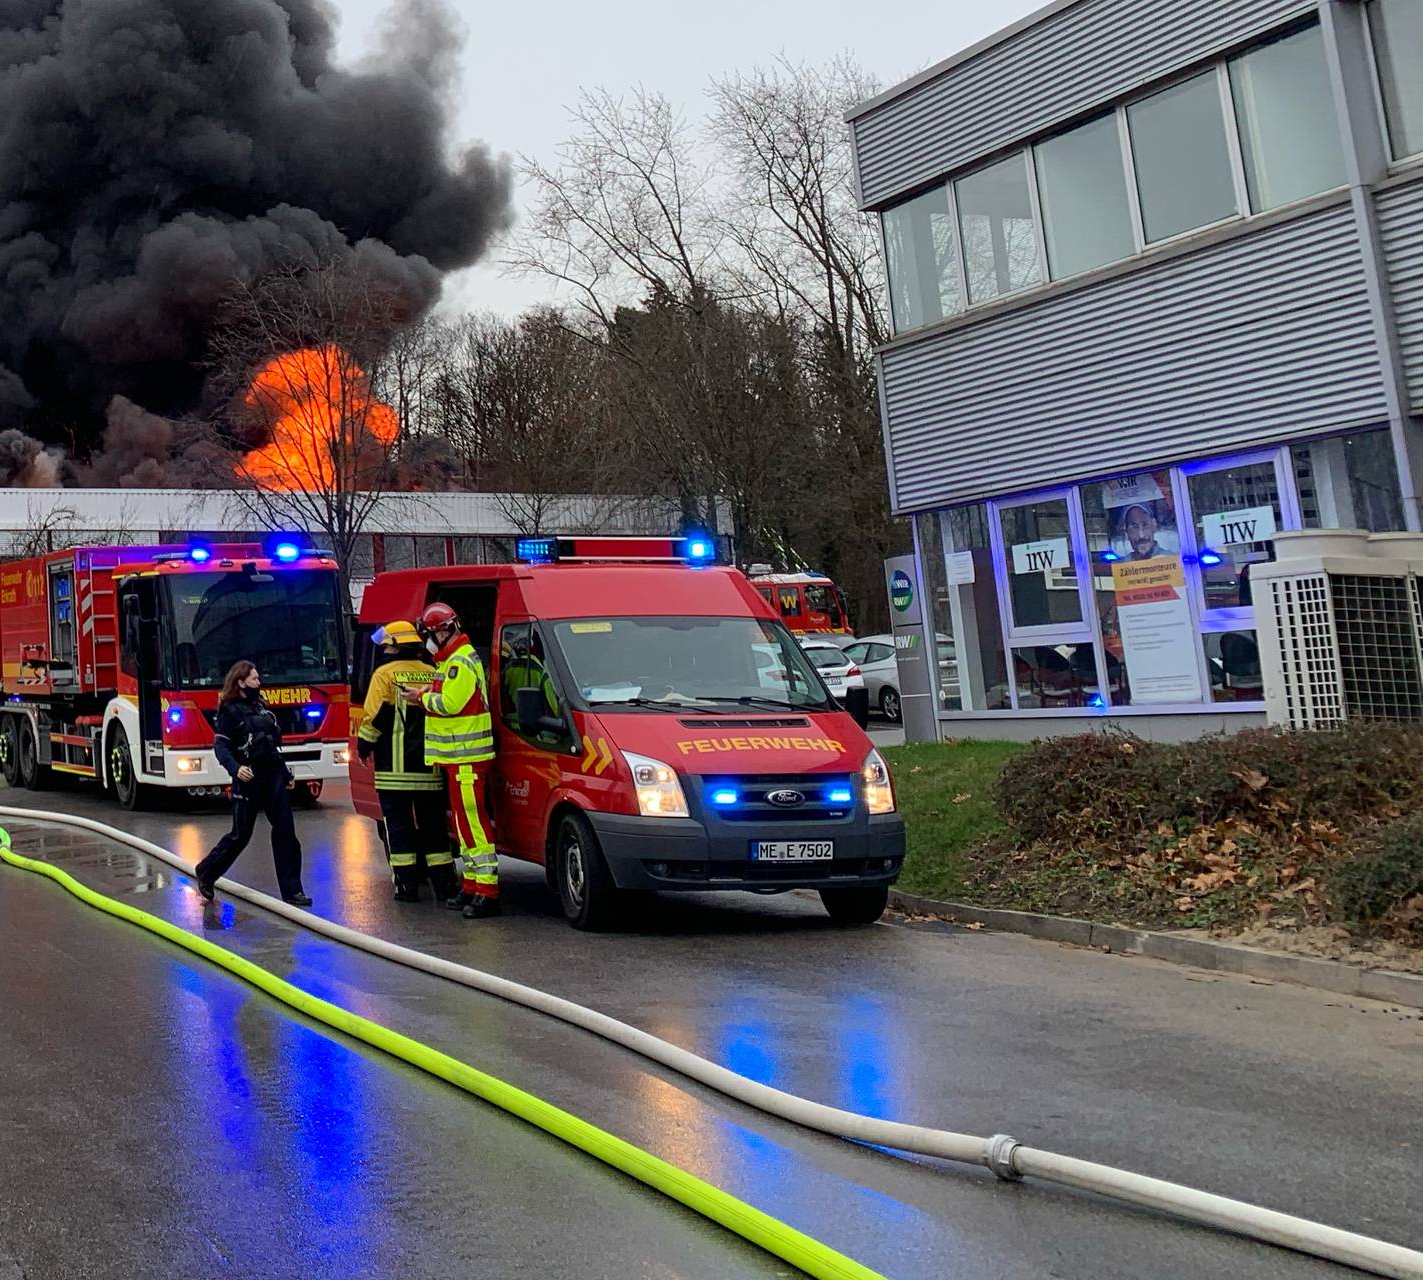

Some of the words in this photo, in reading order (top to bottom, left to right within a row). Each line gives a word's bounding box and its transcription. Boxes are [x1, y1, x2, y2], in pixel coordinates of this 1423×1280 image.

[677, 736, 847, 755] FEUERWEHR
[777, 792, 798, 801] Ford
[759, 844, 778, 859] ME
[787, 844, 796, 859] E
[798, 843, 832, 858] 7502
